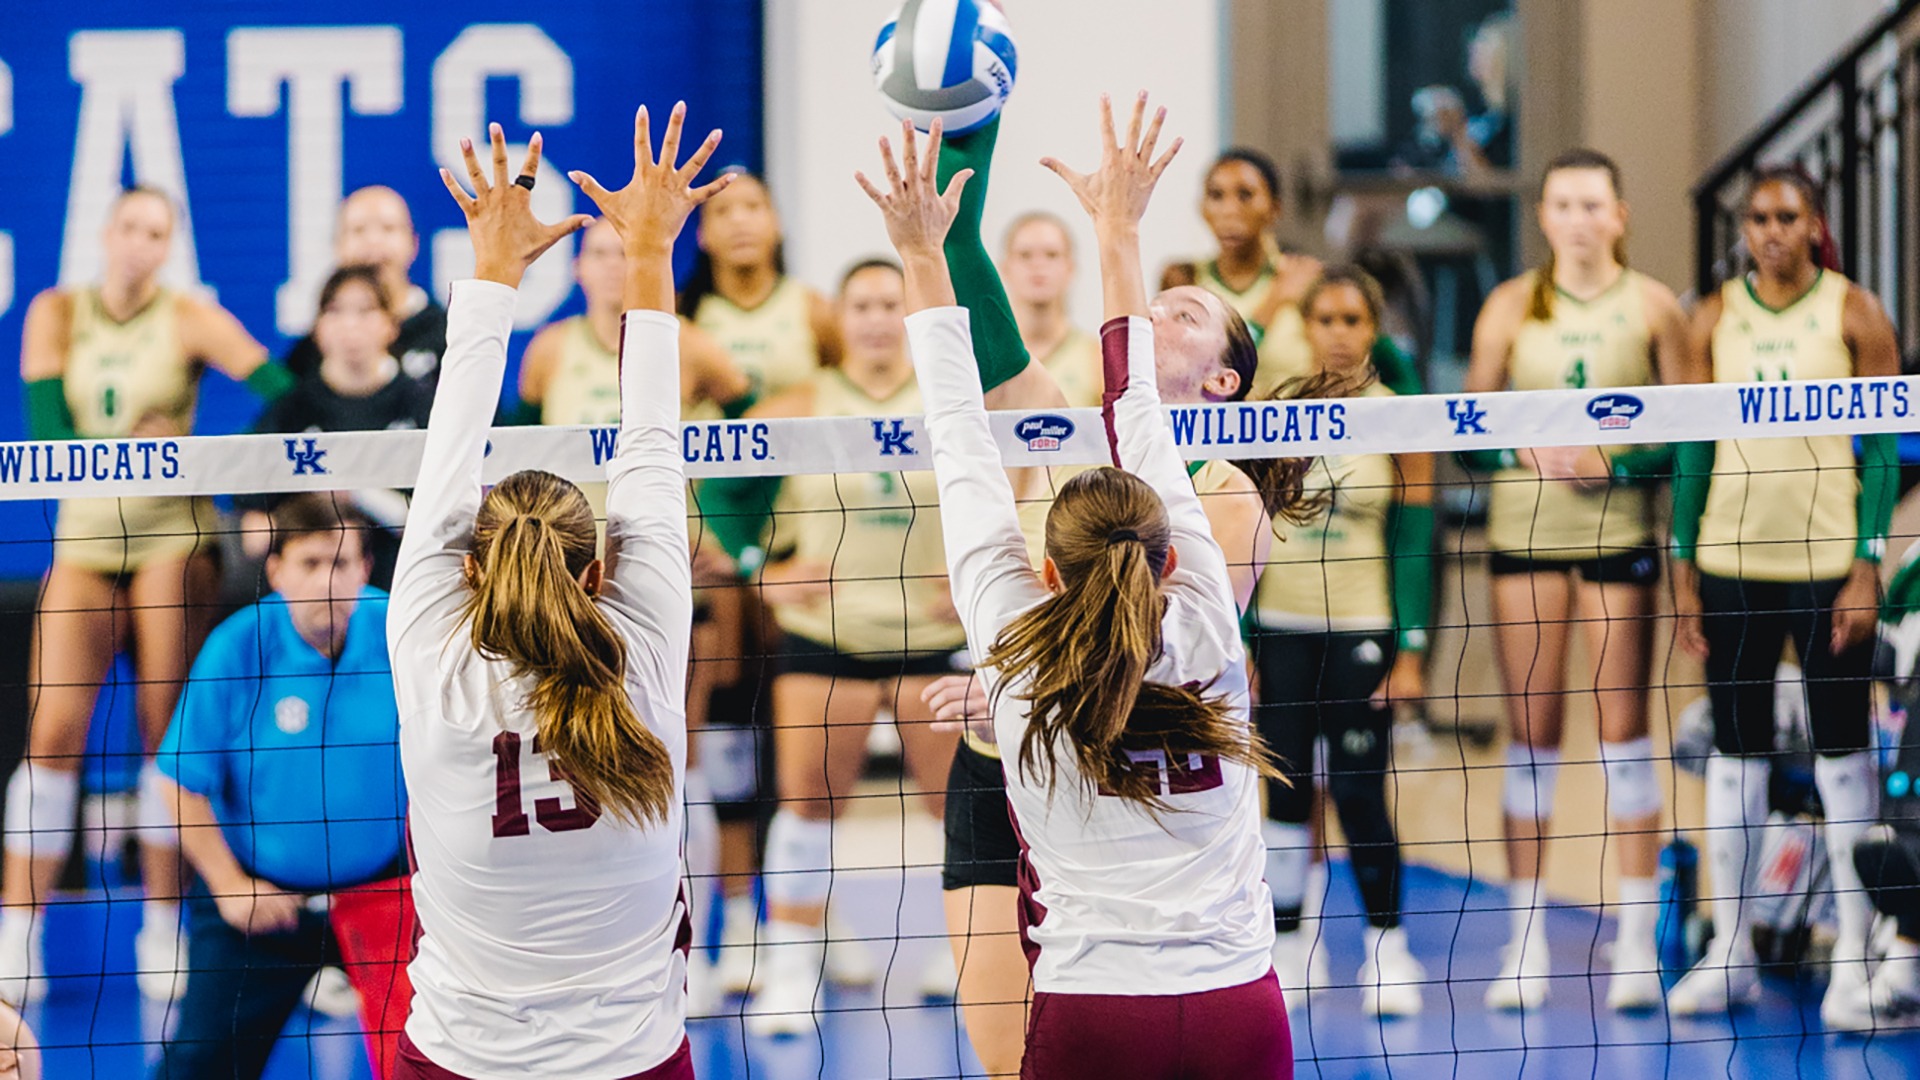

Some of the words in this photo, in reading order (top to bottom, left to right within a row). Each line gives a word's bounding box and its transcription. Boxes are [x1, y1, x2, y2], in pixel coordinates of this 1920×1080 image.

[0, 22, 575, 337] ATS
[1445, 399, 1488, 435] UK
[1738, 381, 1909, 424] WILDCATS
[590, 423, 769, 465] WCATS
[872, 420, 915, 456] UK
[1031, 438, 1058, 448] FORD
[1170, 404, 1346, 445] WILDCATS
[0, 442, 179, 483] WILDCATS
[283, 438, 327, 475] UK
